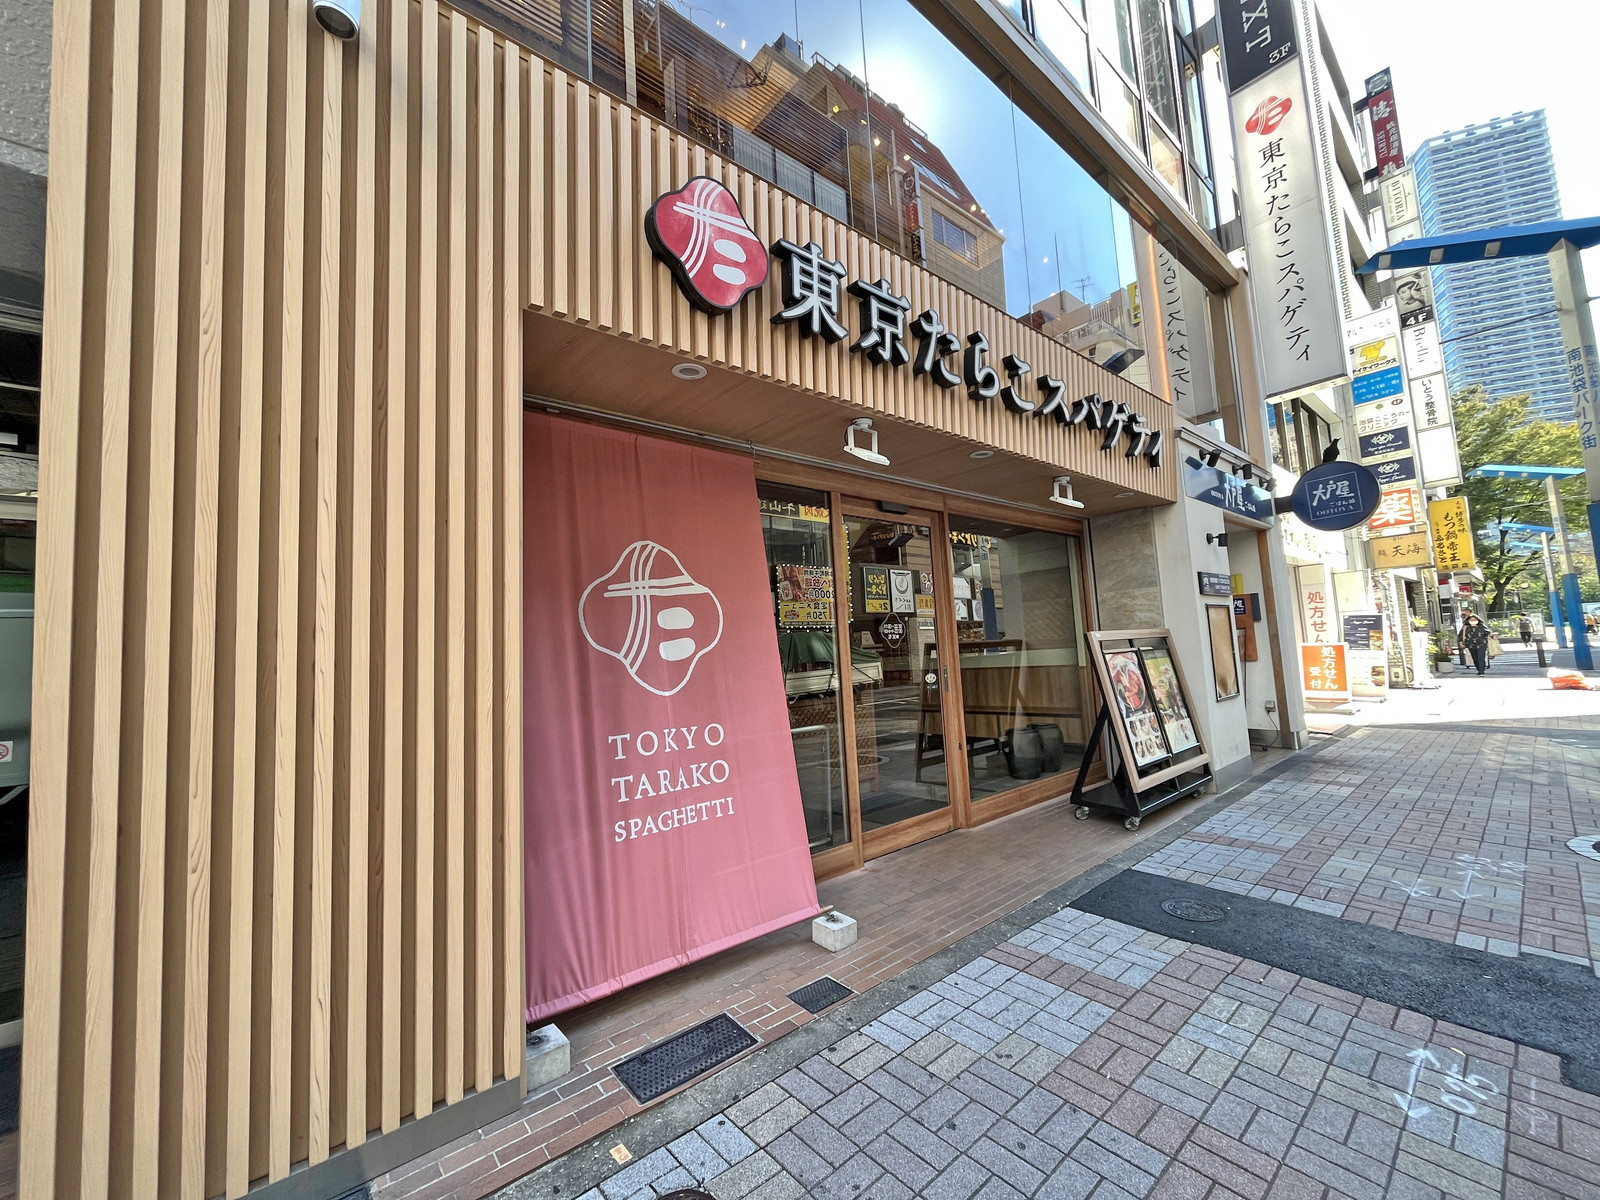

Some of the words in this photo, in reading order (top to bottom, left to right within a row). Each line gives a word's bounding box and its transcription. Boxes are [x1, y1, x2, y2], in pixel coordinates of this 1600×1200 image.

[1240, 0, 1272, 53] XT
[1269, 41, 1291, 64] 3F
[1376, 130, 1388, 159] SEIRYU
[1391, 180, 1405, 222] BITORIA
[1258, 137, 1311, 362] 東京たらこスパゲティ
[1406, 313, 1427, 326] 4F
[772, 239, 1163, 467] 東京たらこスパゲティ
[1422, 379, 1438, 426] いとう整骨院
[1567, 347, 1597, 450] 南池袋パーク街
[1360, 418, 1397, 432] クリニック
[1224, 481, 1246, 512] 大戸屋
[1312, 479, 1355, 507] 大戸屋
[1316, 505, 1355, 517] OOTOYA
[1371, 491, 1413, 526] 薬
[1443, 512, 1460, 562] もつ鍋帝王
[1309, 666, 1322, 689] 受付
[1321, 645, 1339, 690] 処方せん
[608, 723, 725, 760] TOKYO
[611, 760, 730, 803] TARAKO
[614, 797, 735, 842] SPAGHETTI
